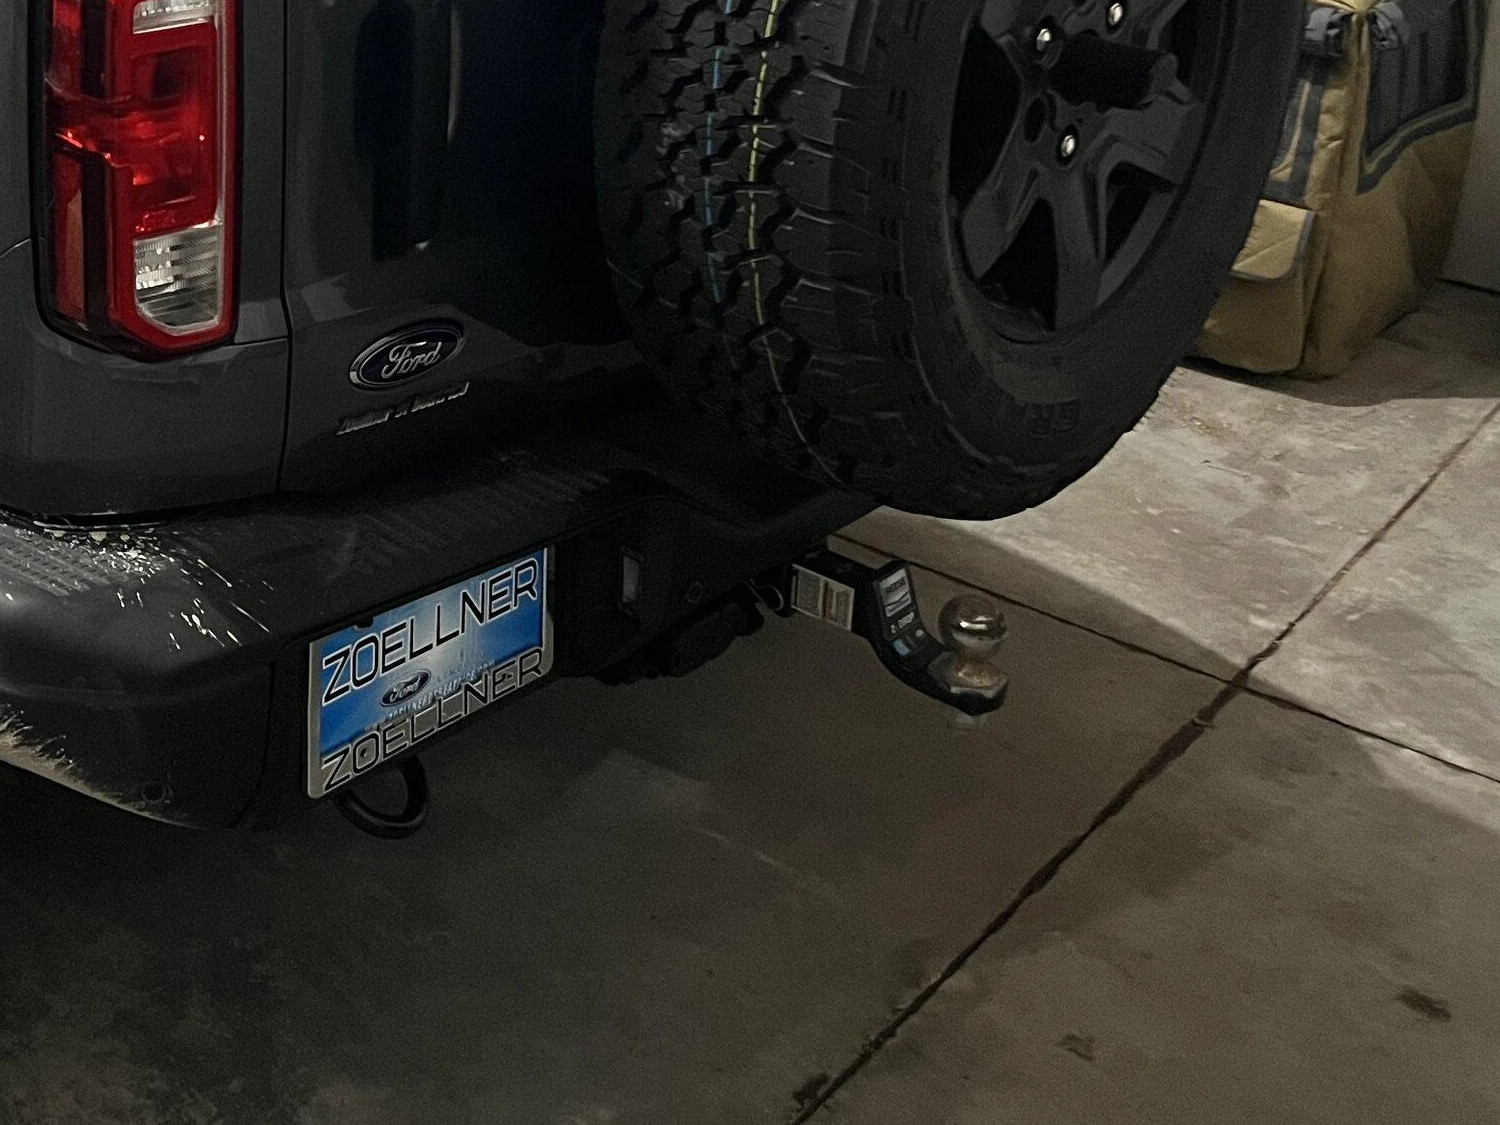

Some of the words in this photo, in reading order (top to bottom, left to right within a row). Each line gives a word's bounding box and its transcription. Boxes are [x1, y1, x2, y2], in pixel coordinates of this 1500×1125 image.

[381, 341, 443, 379] Ford
[322, 557, 539, 707] ZOELLNER
[321, 646, 543, 793] ZOELLNER
[388, 679, 424, 703] Ford
